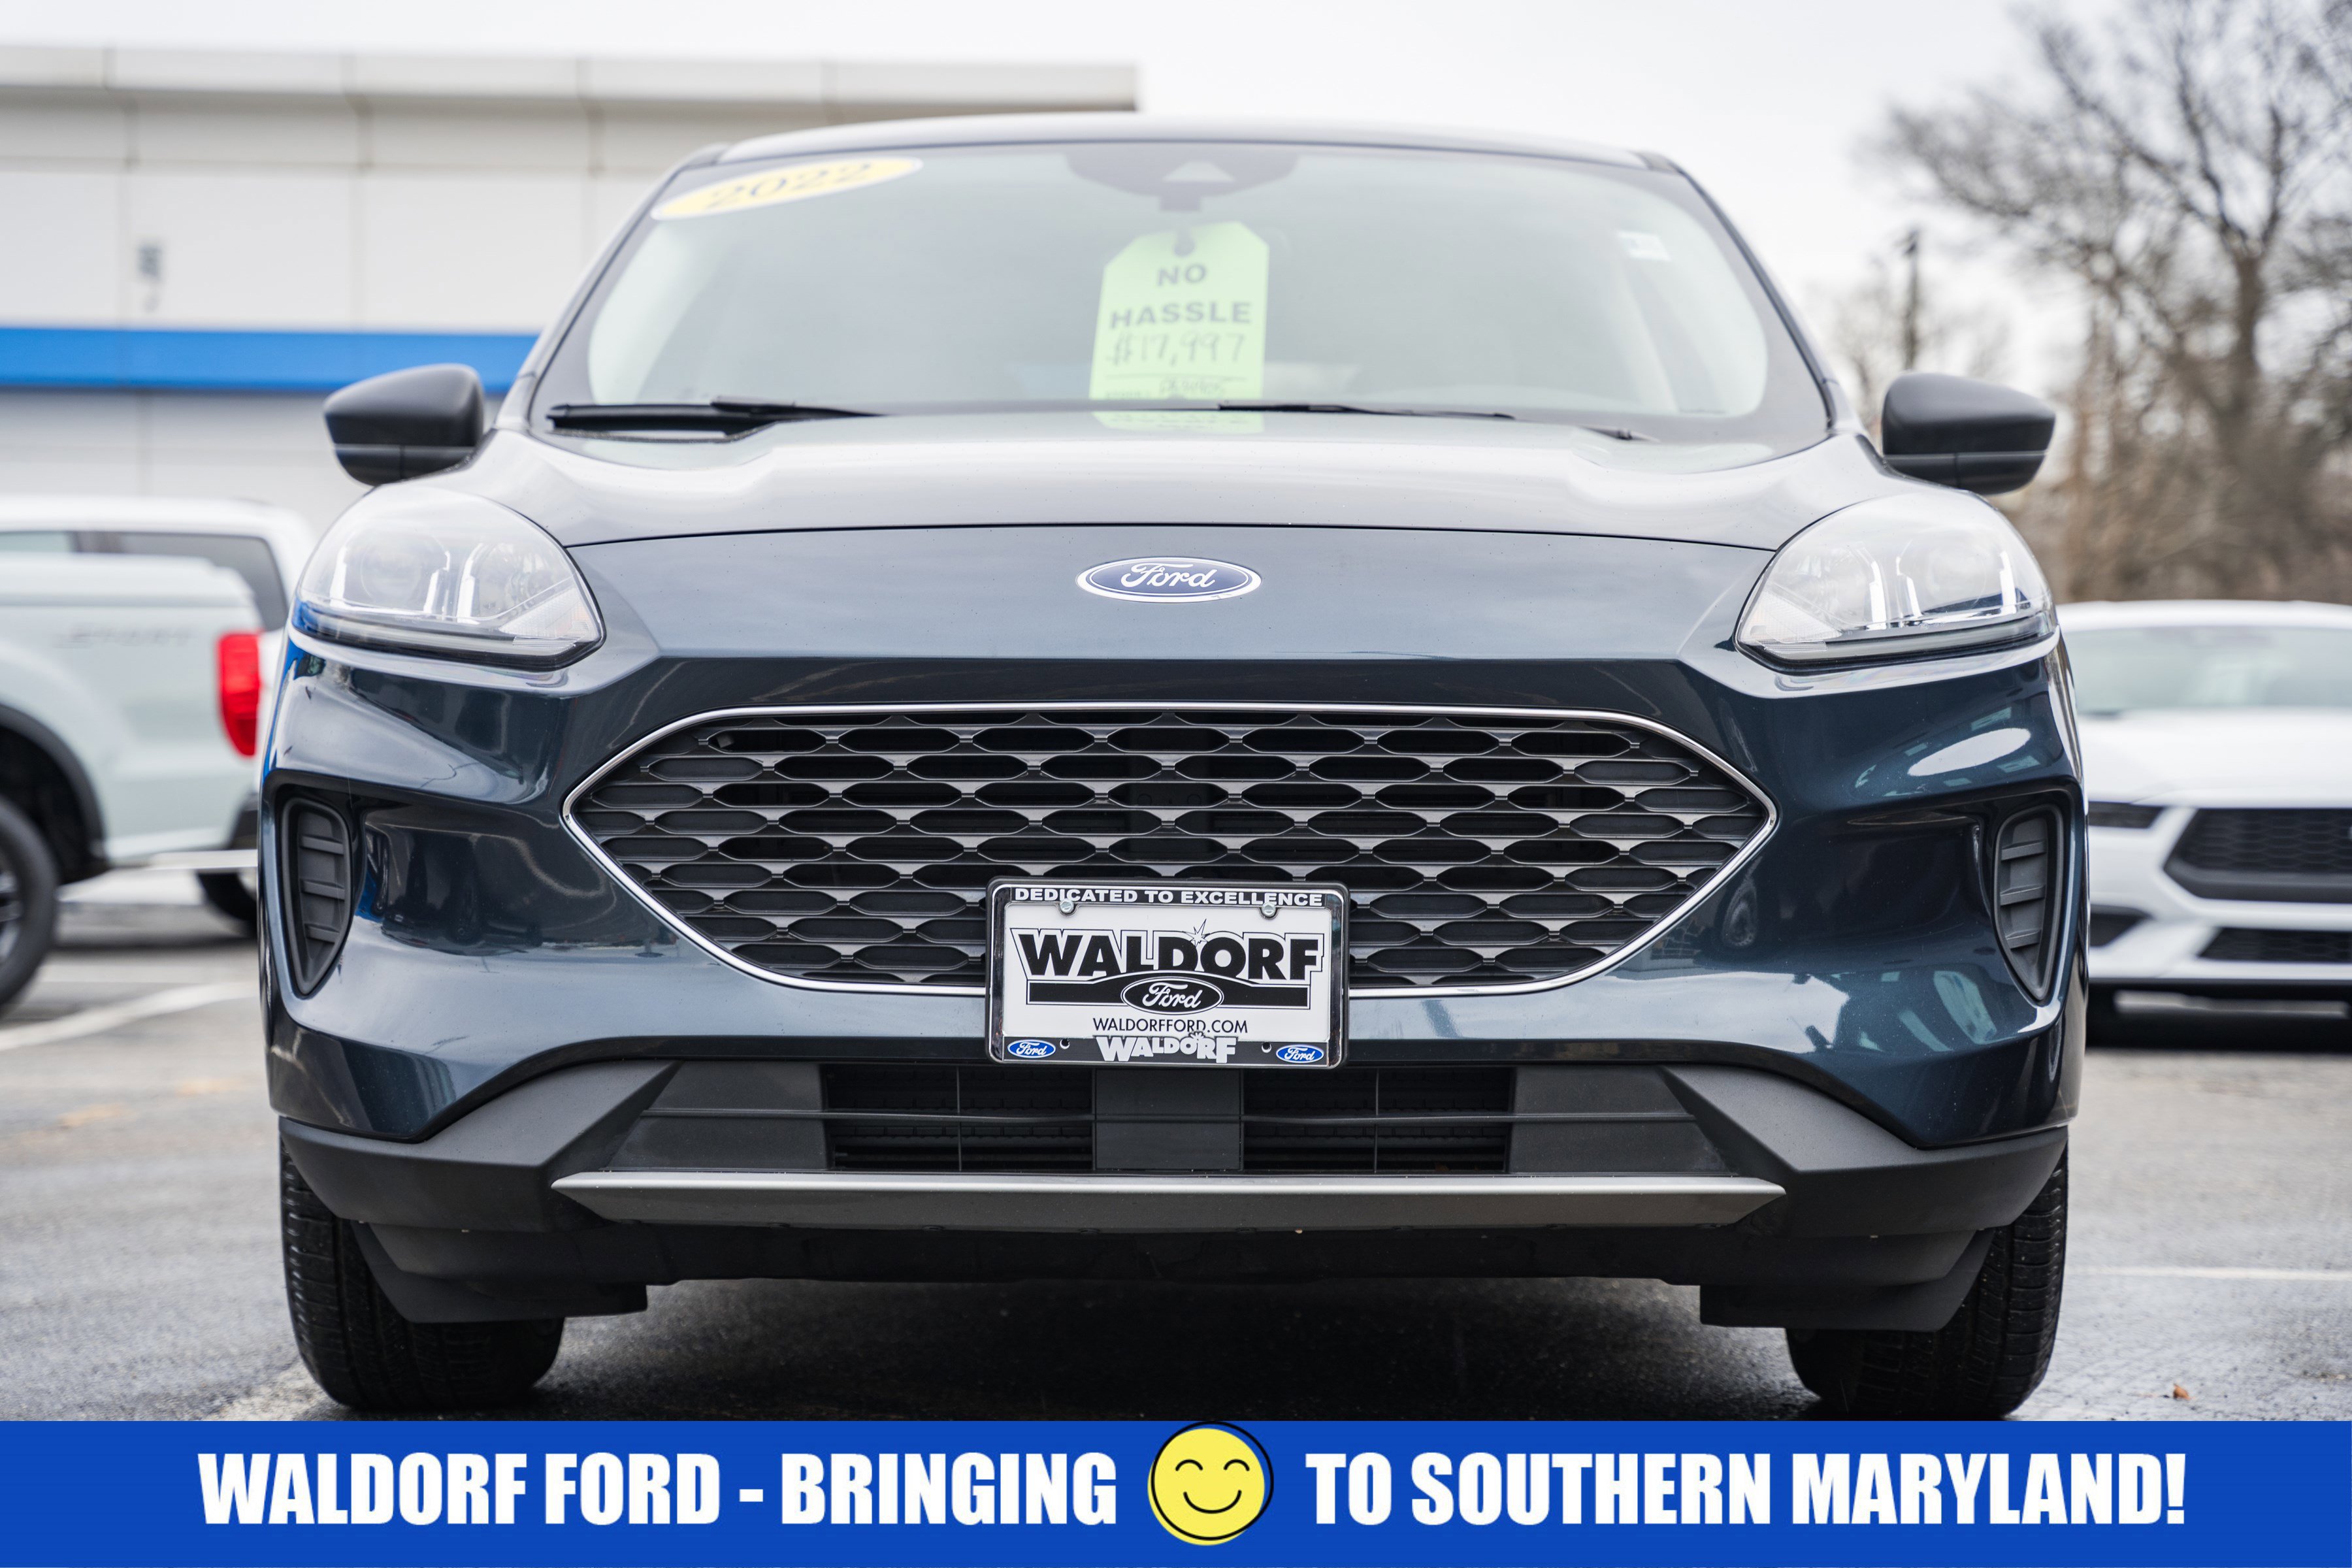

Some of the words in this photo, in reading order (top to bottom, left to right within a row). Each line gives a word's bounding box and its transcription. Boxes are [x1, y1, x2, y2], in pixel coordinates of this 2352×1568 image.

[706, 162, 871, 207] 2022
[1158, 263, 1207, 286] NO
[1110, 301, 1252, 329] HASSLE
[1120, 563, 1217, 587] Ford
[1015, 889, 1137, 902] DEDICATED
[1145, 890, 1173, 903] TO
[1181, 891, 1322, 906] EXCELLENCE
[1017, 932, 1319, 980] WALDORF
[1142, 982, 1203, 1008] Ford
[1093, 1018, 1248, 1033] WALDORFFORD.COM
[1016, 1042, 1048, 1056] Ford
[1096, 1036, 1237, 1064] WALDORF
[1284, 1047, 1316, 1060] Ford
